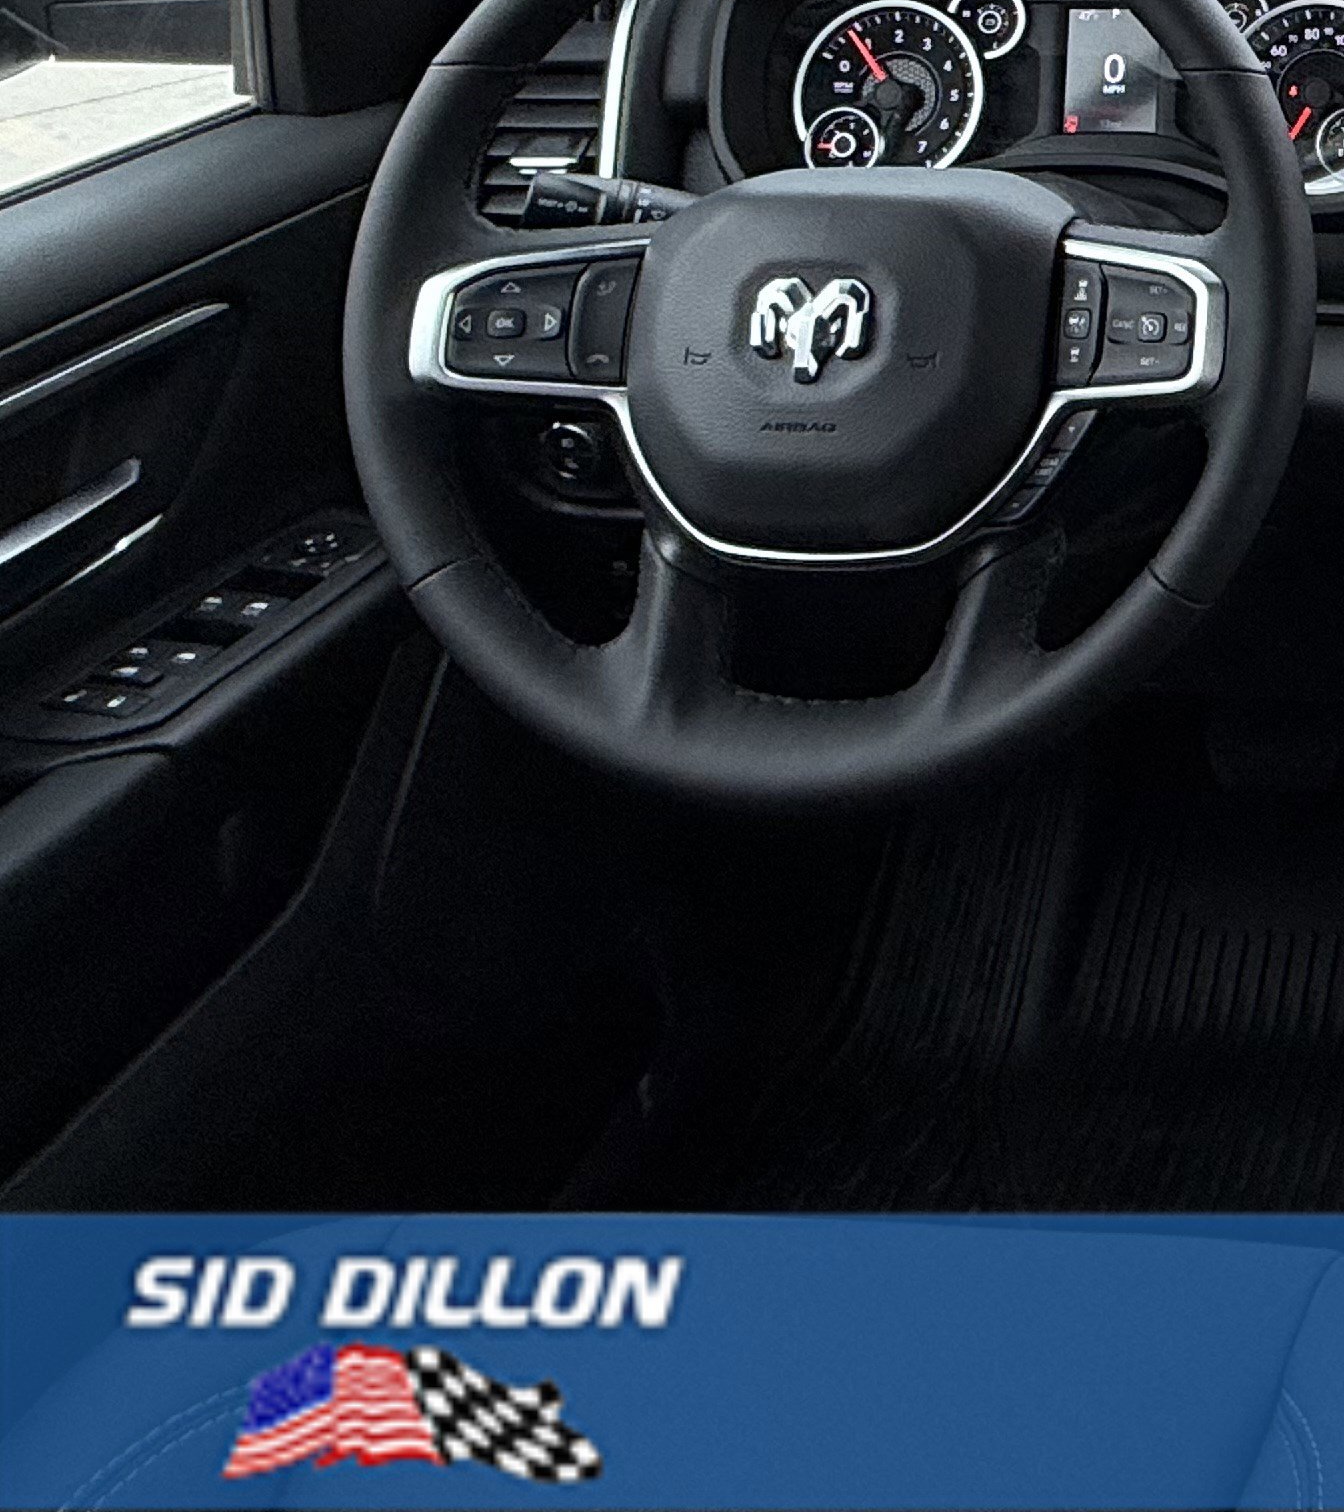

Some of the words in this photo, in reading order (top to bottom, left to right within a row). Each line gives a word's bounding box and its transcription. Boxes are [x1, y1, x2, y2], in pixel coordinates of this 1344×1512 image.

[894, 29, 904, 44] 2
[1304, 27, 1320, 41] 80
[922, 37, 932, 51] 3
[1270, 44, 1288, 57] 60
[838, 60, 851, 73] 0
[943, 59, 953, 72] 4
[1103, 52, 1126, 84] 0
[950, 89, 960, 102] 5
[940, 118, 950, 131] 6
[917, 141, 928, 154] 7
